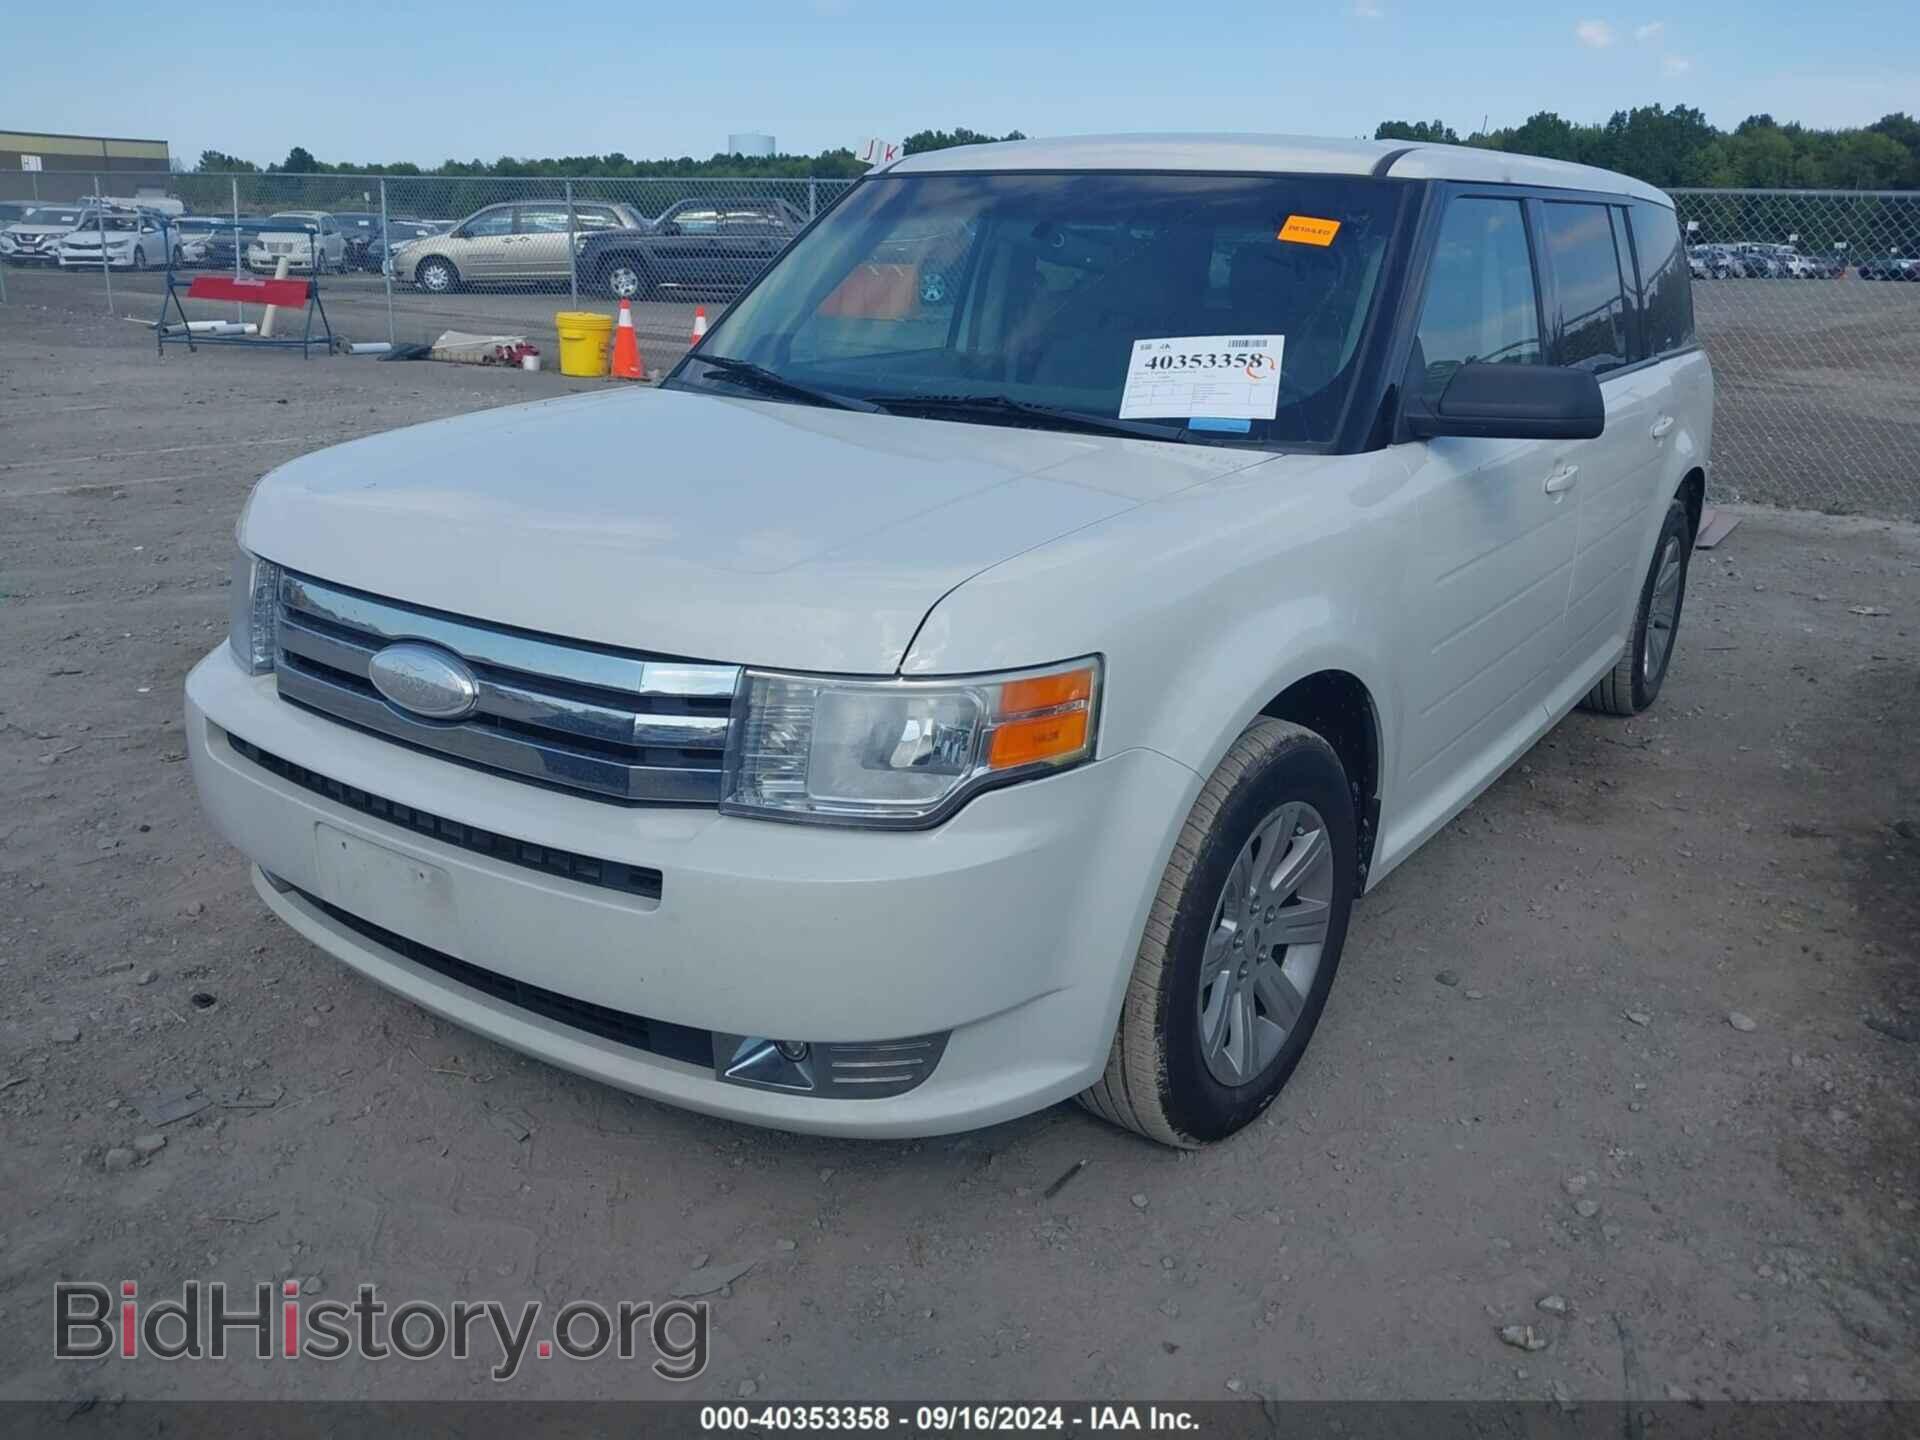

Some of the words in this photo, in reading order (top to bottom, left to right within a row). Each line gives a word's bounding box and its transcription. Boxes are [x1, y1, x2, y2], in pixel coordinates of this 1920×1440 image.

[863, 140, 874, 160] J
[885, 144, 899, 161] K
[1144, 353, 1263, 369] 40353358
